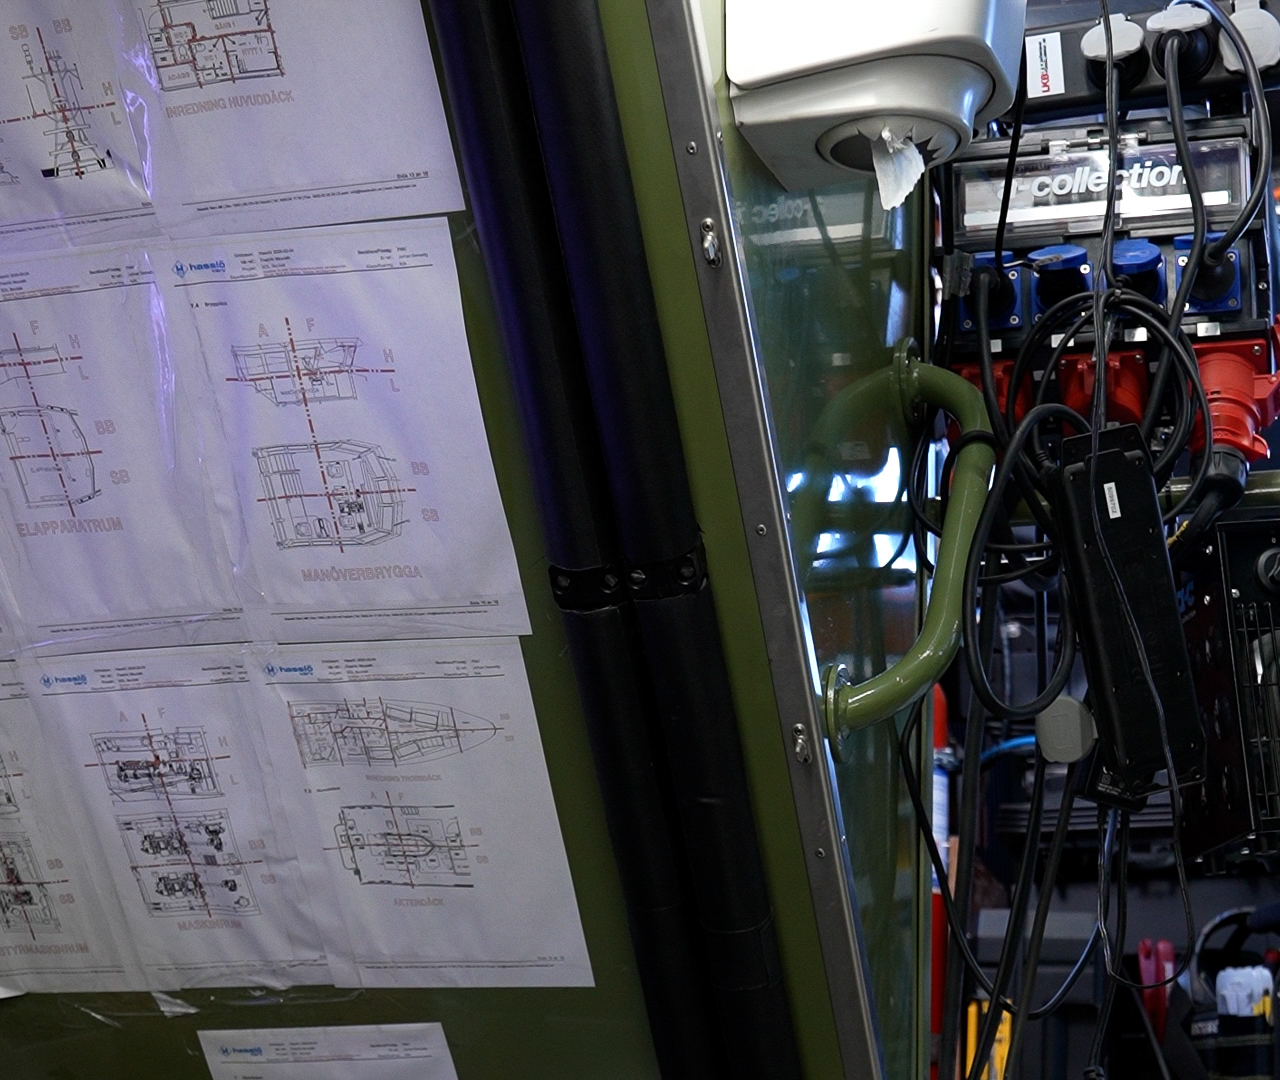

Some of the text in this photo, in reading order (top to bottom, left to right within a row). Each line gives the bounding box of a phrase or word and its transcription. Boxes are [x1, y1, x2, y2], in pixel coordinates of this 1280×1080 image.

[9, 24, 30, 41] SB
[52, 18, 73, 35] BB
[102, 82, 114, 97] H
[1041, 73, 1051, 93] LKB
[165, 90, 295, 118] INREDNING HUVUDDÄCK
[110, 111, 121, 126] L
[997, 161, 1187, 200] a-collection
[189, 260, 226, 271] hasslö
[30, 320, 39, 335] F
[258, 324, 269, 338] A
[306, 318, 315, 332] F
[69, 334, 81, 349] H
[383, 349, 395, 363] H
[78, 365, 89, 381] L
[390, 378, 400, 393] L
[94, 419, 117, 435] BB
[410, 461, 430, 476] BB
[109, 469, 131, 486] SB
[421, 508, 440, 522] SB
[15, 517, 124, 538] ELAPPARATRUM
[301, 566, 423, 583] MANÖVERBRYGGA
[279, 664, 313, 674] hasslö
[54, 674, 87, 685] hasslö
[120, 712, 128, 723] A
[157, 707, 165, 718] F
[218, 736, 228, 747] H
[393, 897, 445, 907] AKTERDÄCK
[177, 918, 243, 931] MASKINRUM
